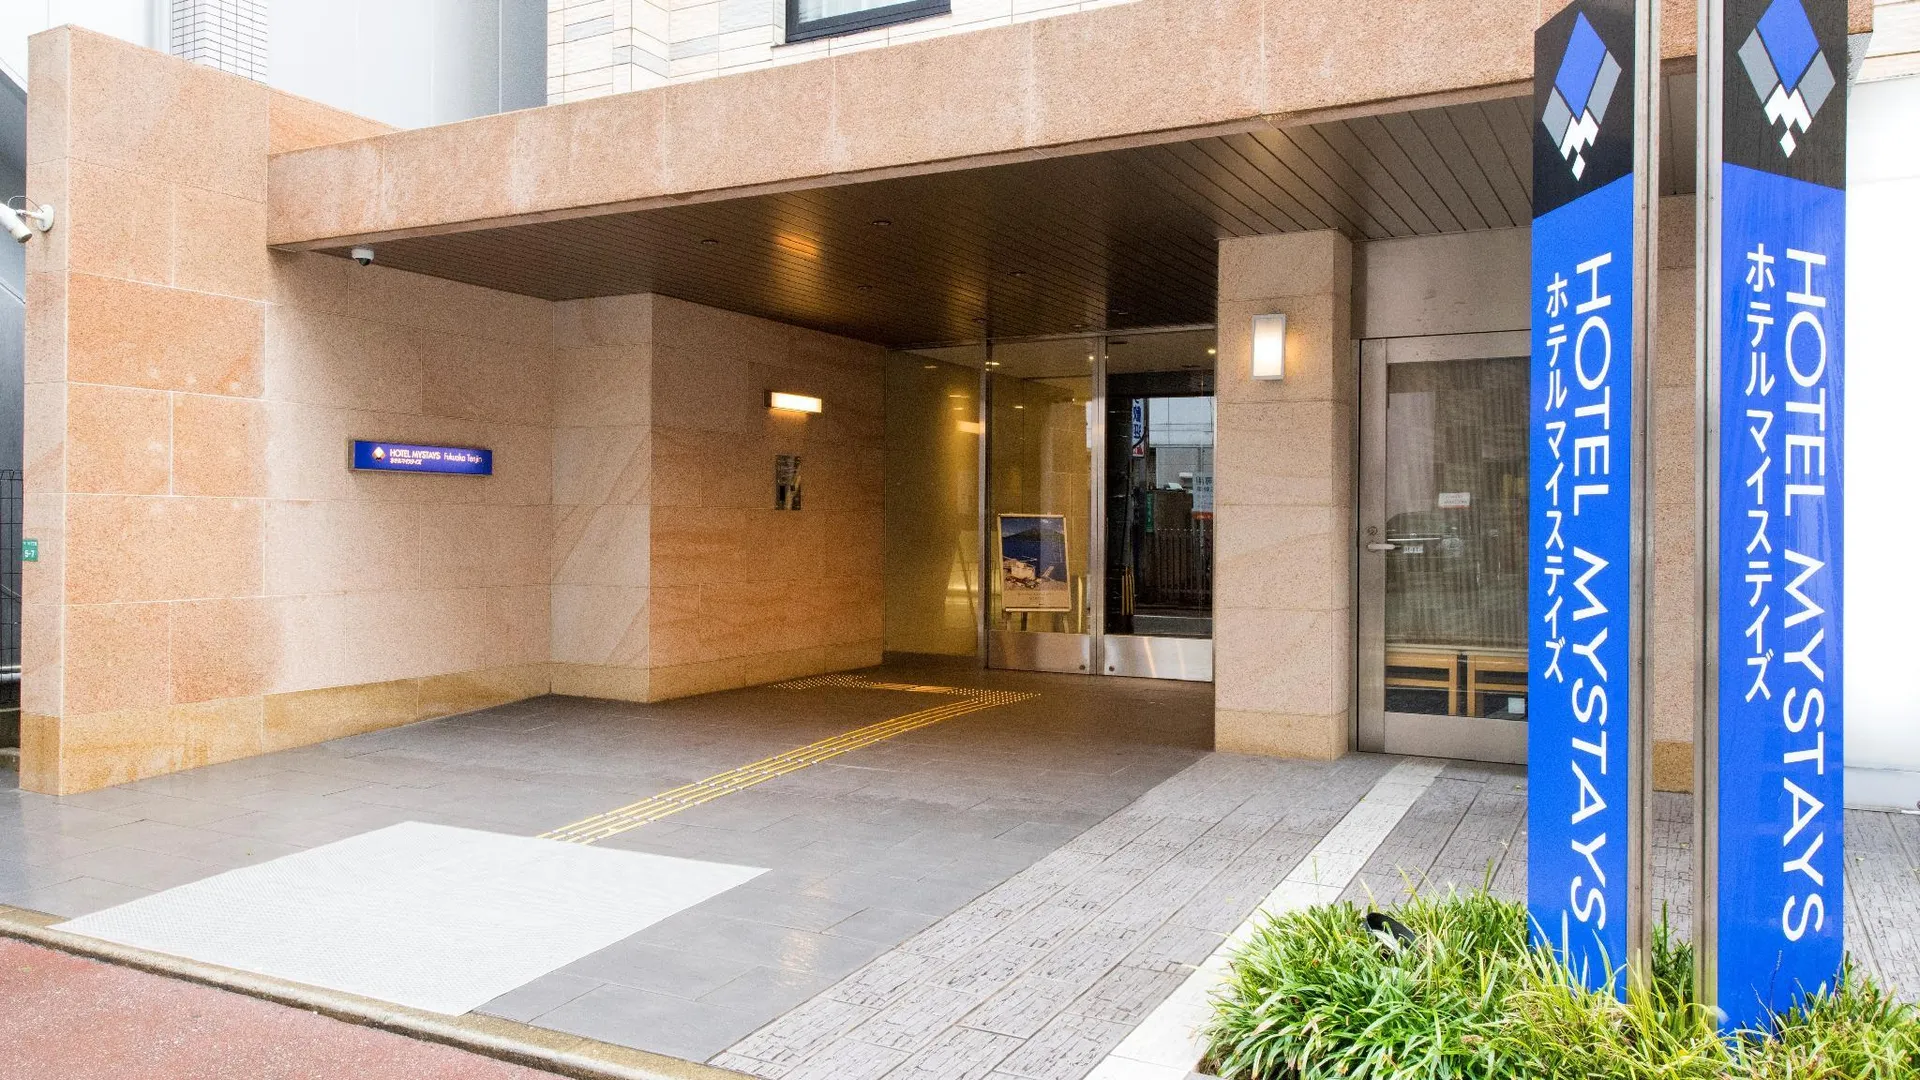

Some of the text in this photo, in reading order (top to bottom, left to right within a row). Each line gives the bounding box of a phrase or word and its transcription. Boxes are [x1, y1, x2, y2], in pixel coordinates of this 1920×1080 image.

[390, 449, 411, 458] HOTEL
[412, 450, 441, 460] MYSTAYS
[444, 453, 466, 462] Fukuoka
[1571, 252, 1612, 931] HOTEL MYSTAYS
[1782, 248, 1827, 943] HOTEL MYSTAYS
